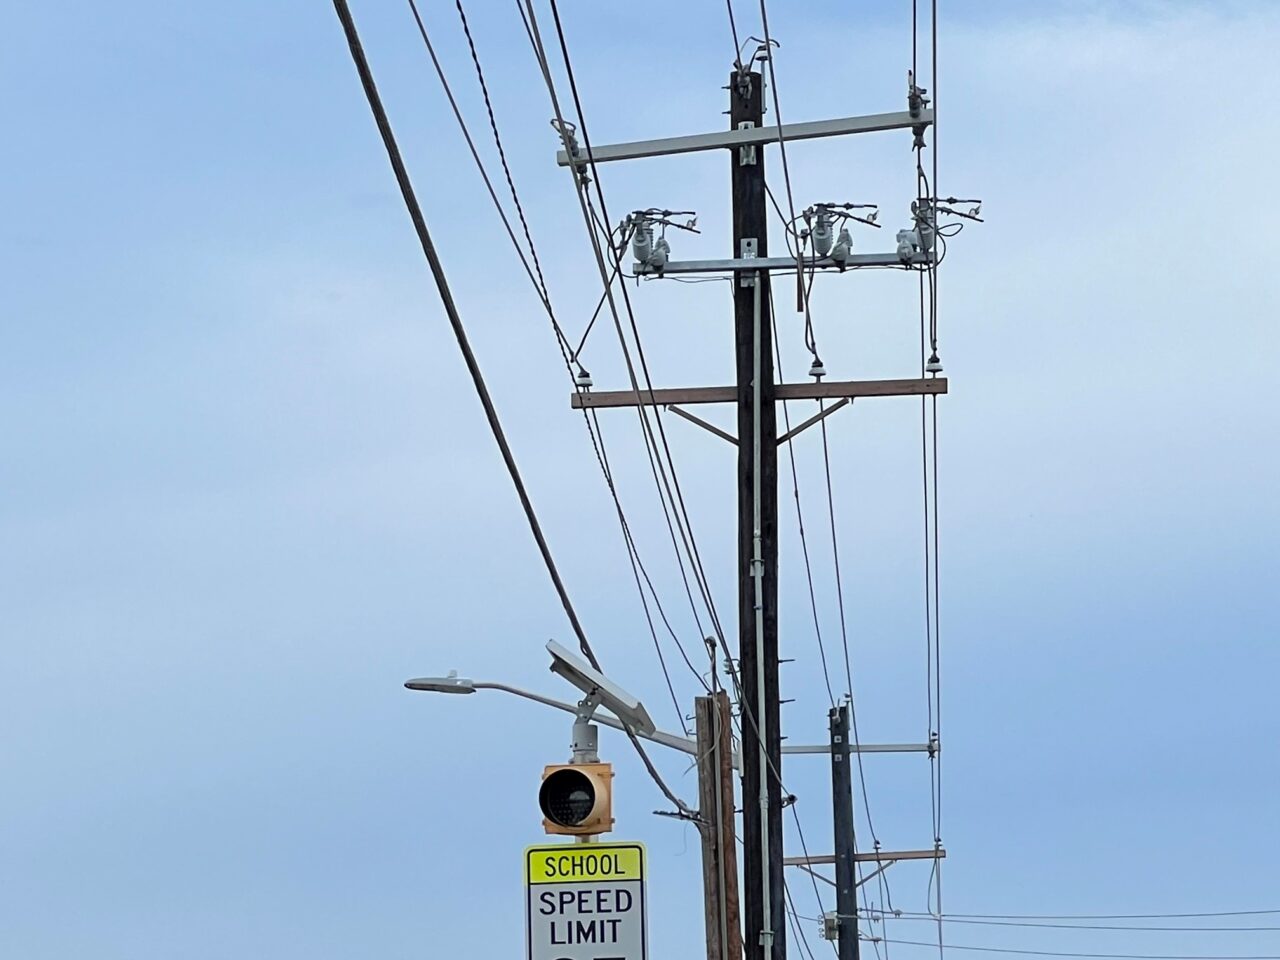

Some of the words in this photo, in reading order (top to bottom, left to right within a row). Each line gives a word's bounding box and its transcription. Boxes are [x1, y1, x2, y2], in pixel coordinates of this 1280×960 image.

[544, 853, 626, 877] SCHOOL
[539, 889, 633, 915] SPEED
[550, 919, 622, 945] LIMIT
